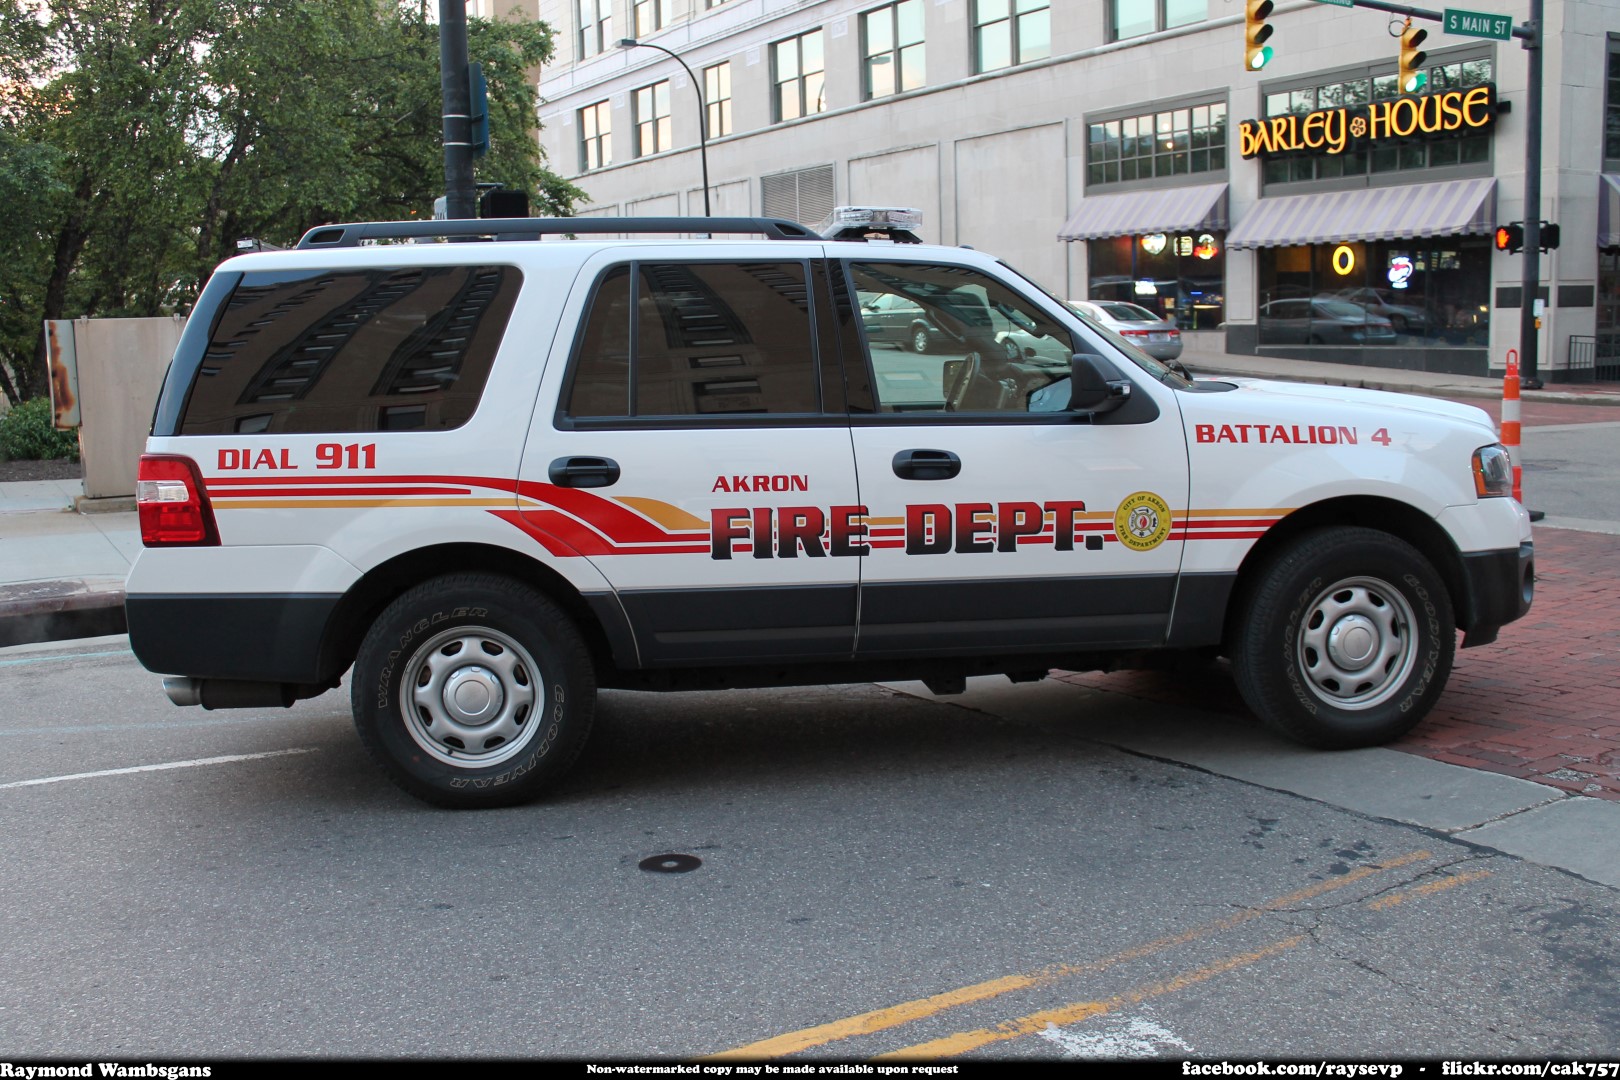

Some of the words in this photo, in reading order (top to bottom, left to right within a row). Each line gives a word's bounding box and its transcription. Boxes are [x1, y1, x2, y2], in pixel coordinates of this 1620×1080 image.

[1450, 15, 1457, 29] S
[1462, 16, 1490, 33] MAIN
[1494, 20, 1507, 35] ST
[1239, 108, 1347, 155] BARLEY
[1368, 87, 1489, 139] HOUSE
[1195, 424, 1358, 446] BATTALION
[1370, 428, 1392, 446] 4
[217, 448, 298, 470] DIAL
[315, 443, 376, 469] 911
[712, 475, 809, 493] AKRON
[1123, 498, 1135, 511] CITY
[1147, 496, 1166, 513] AKRON
[711, 504, 872, 560] FIRE
[905, 500, 1104, 555] DEPT.
[1118, 524, 1129, 540] FIRE
[1128, 527, 1166, 547] DEPARTMENT
[378, 607, 489, 709] WRANGLER
[450, 684, 565, 788] GOODYEAR
